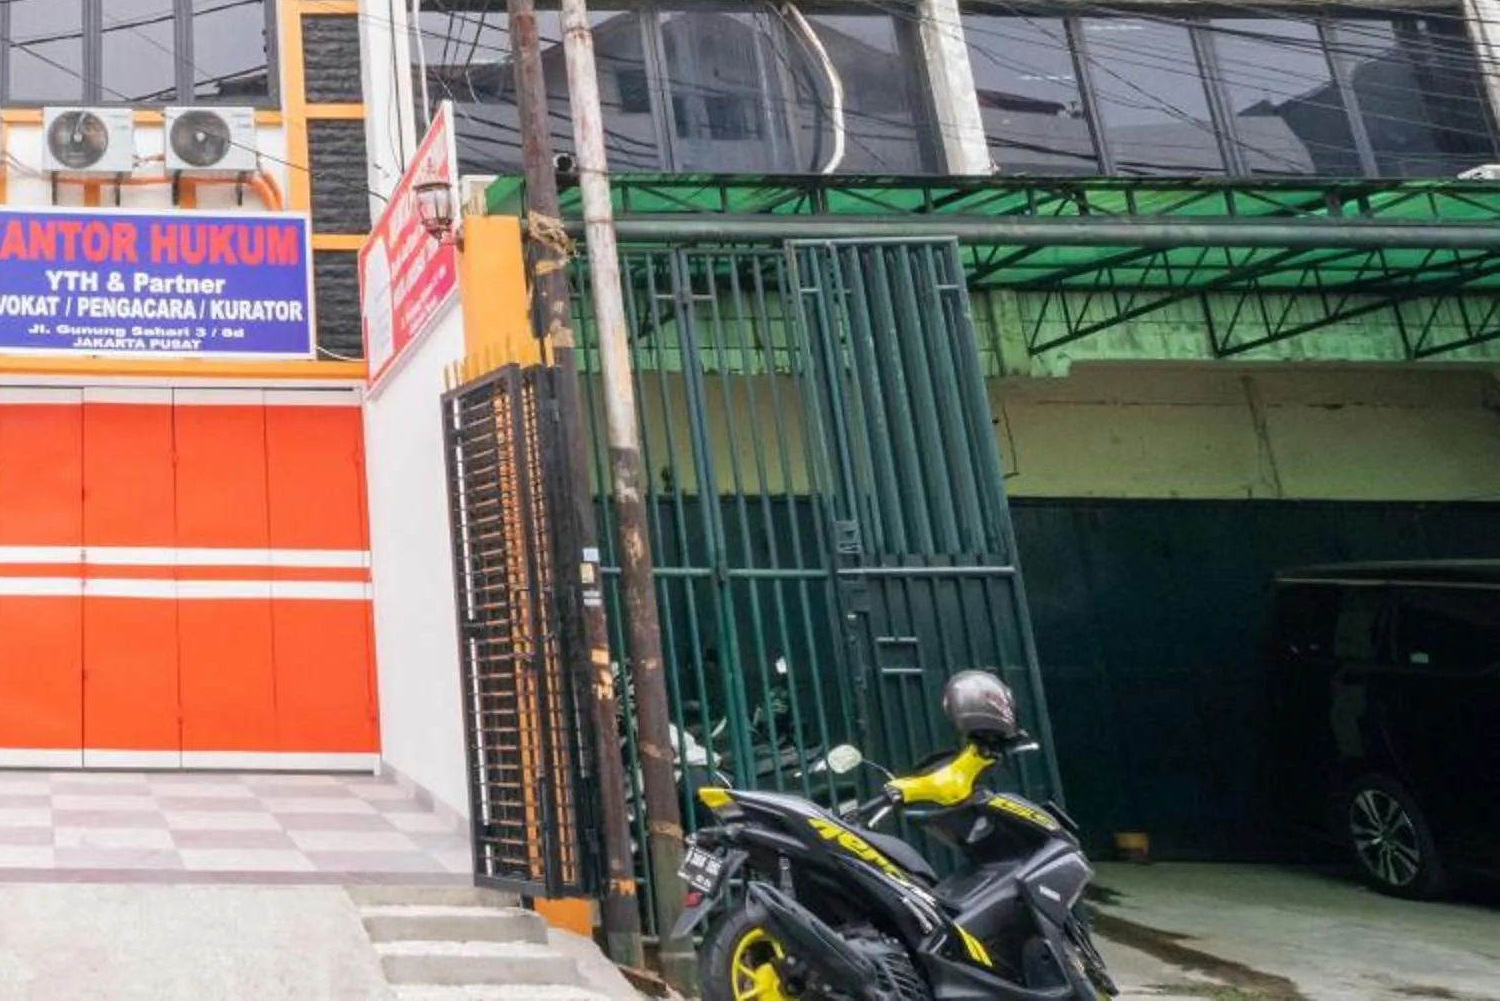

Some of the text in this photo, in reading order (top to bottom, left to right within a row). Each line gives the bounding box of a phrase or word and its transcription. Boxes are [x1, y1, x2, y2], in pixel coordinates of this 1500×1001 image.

[151, 223, 298, 266] HUKUM
[45, 270, 226, 295] YTH & Partner
[65, 296, 73, 317] /
[77, 297, 197, 319] PENGACARA
[210, 300, 303, 321] KURATOR
[28, 323, 51, 335] Jl.
[56, 324, 127, 338] Gunung
[131, 326, 190, 338] Sahari
[73, 336, 202, 350] JAKARTA PUSAT
